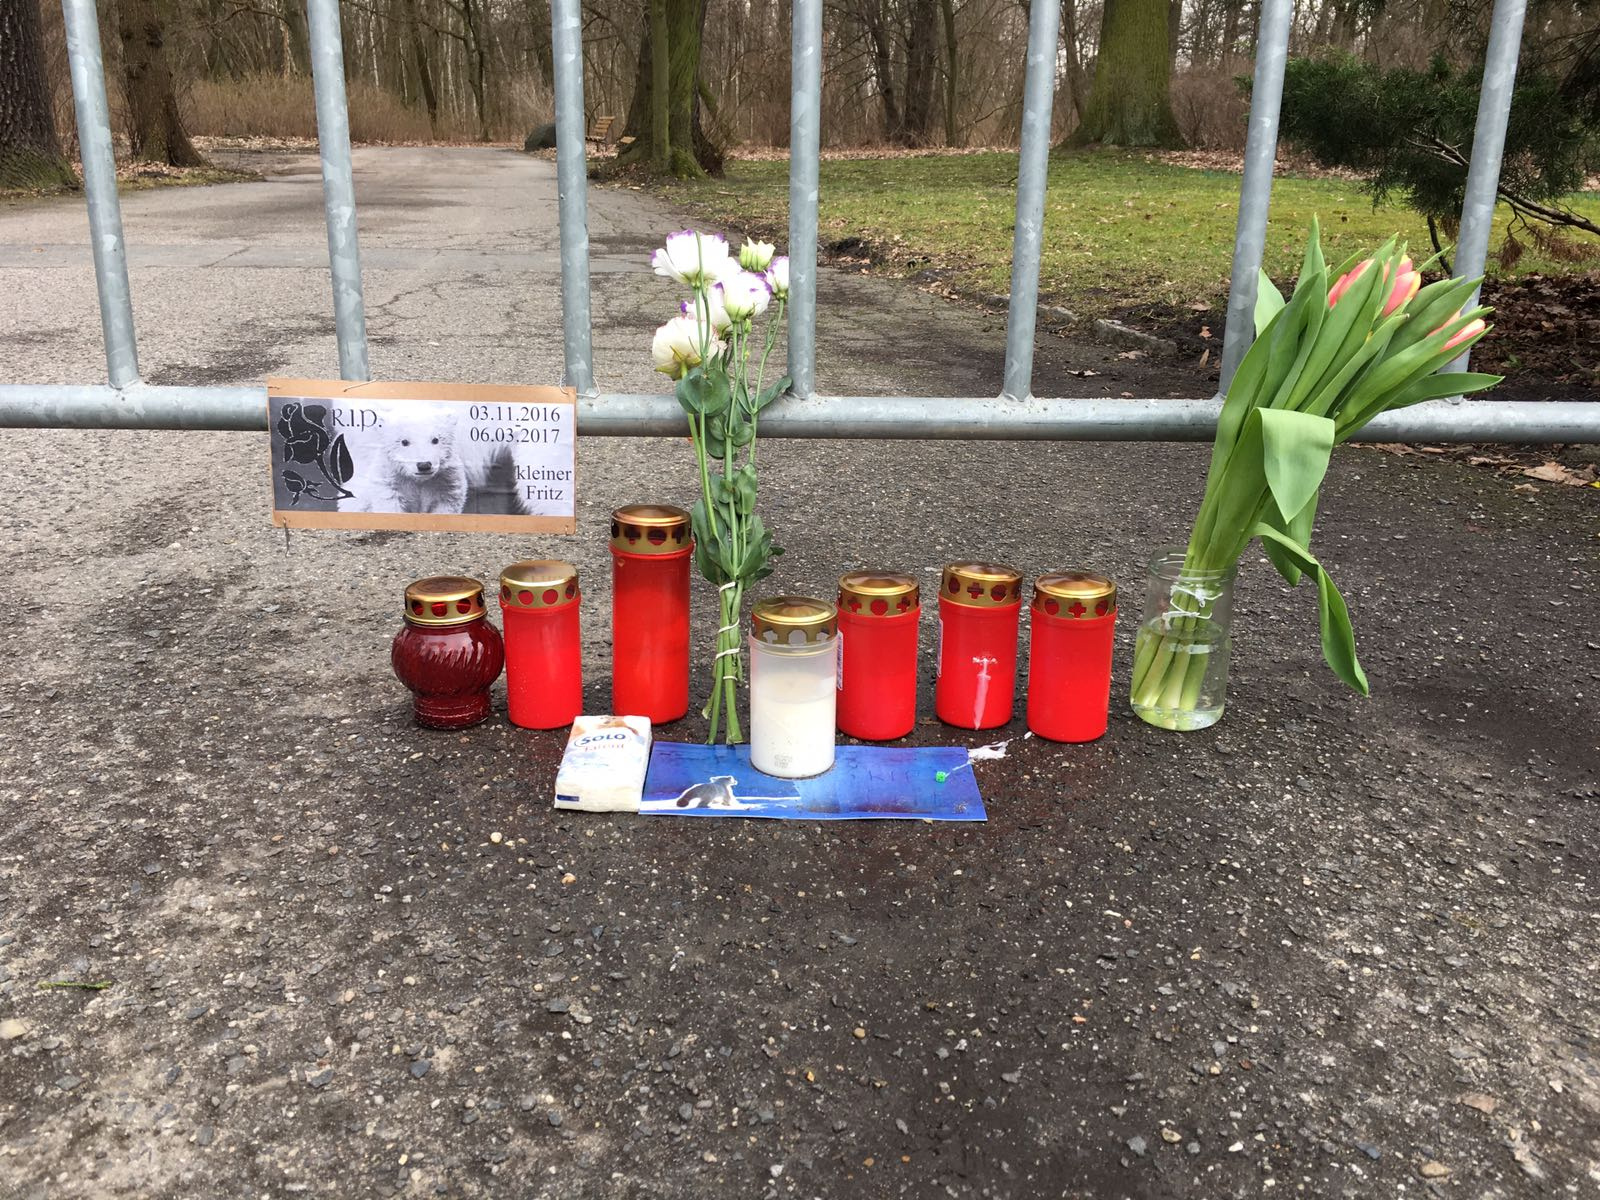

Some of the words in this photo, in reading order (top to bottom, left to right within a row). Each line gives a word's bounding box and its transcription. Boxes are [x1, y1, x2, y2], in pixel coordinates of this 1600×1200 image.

[332, 408, 382, 432] R.I.P.
[469, 405, 560, 422] 03.11.2016
[470, 427, 560, 443] 06.03.2017
[515, 465, 572, 481] kleiner
[526, 486, 564, 501] Fritz
